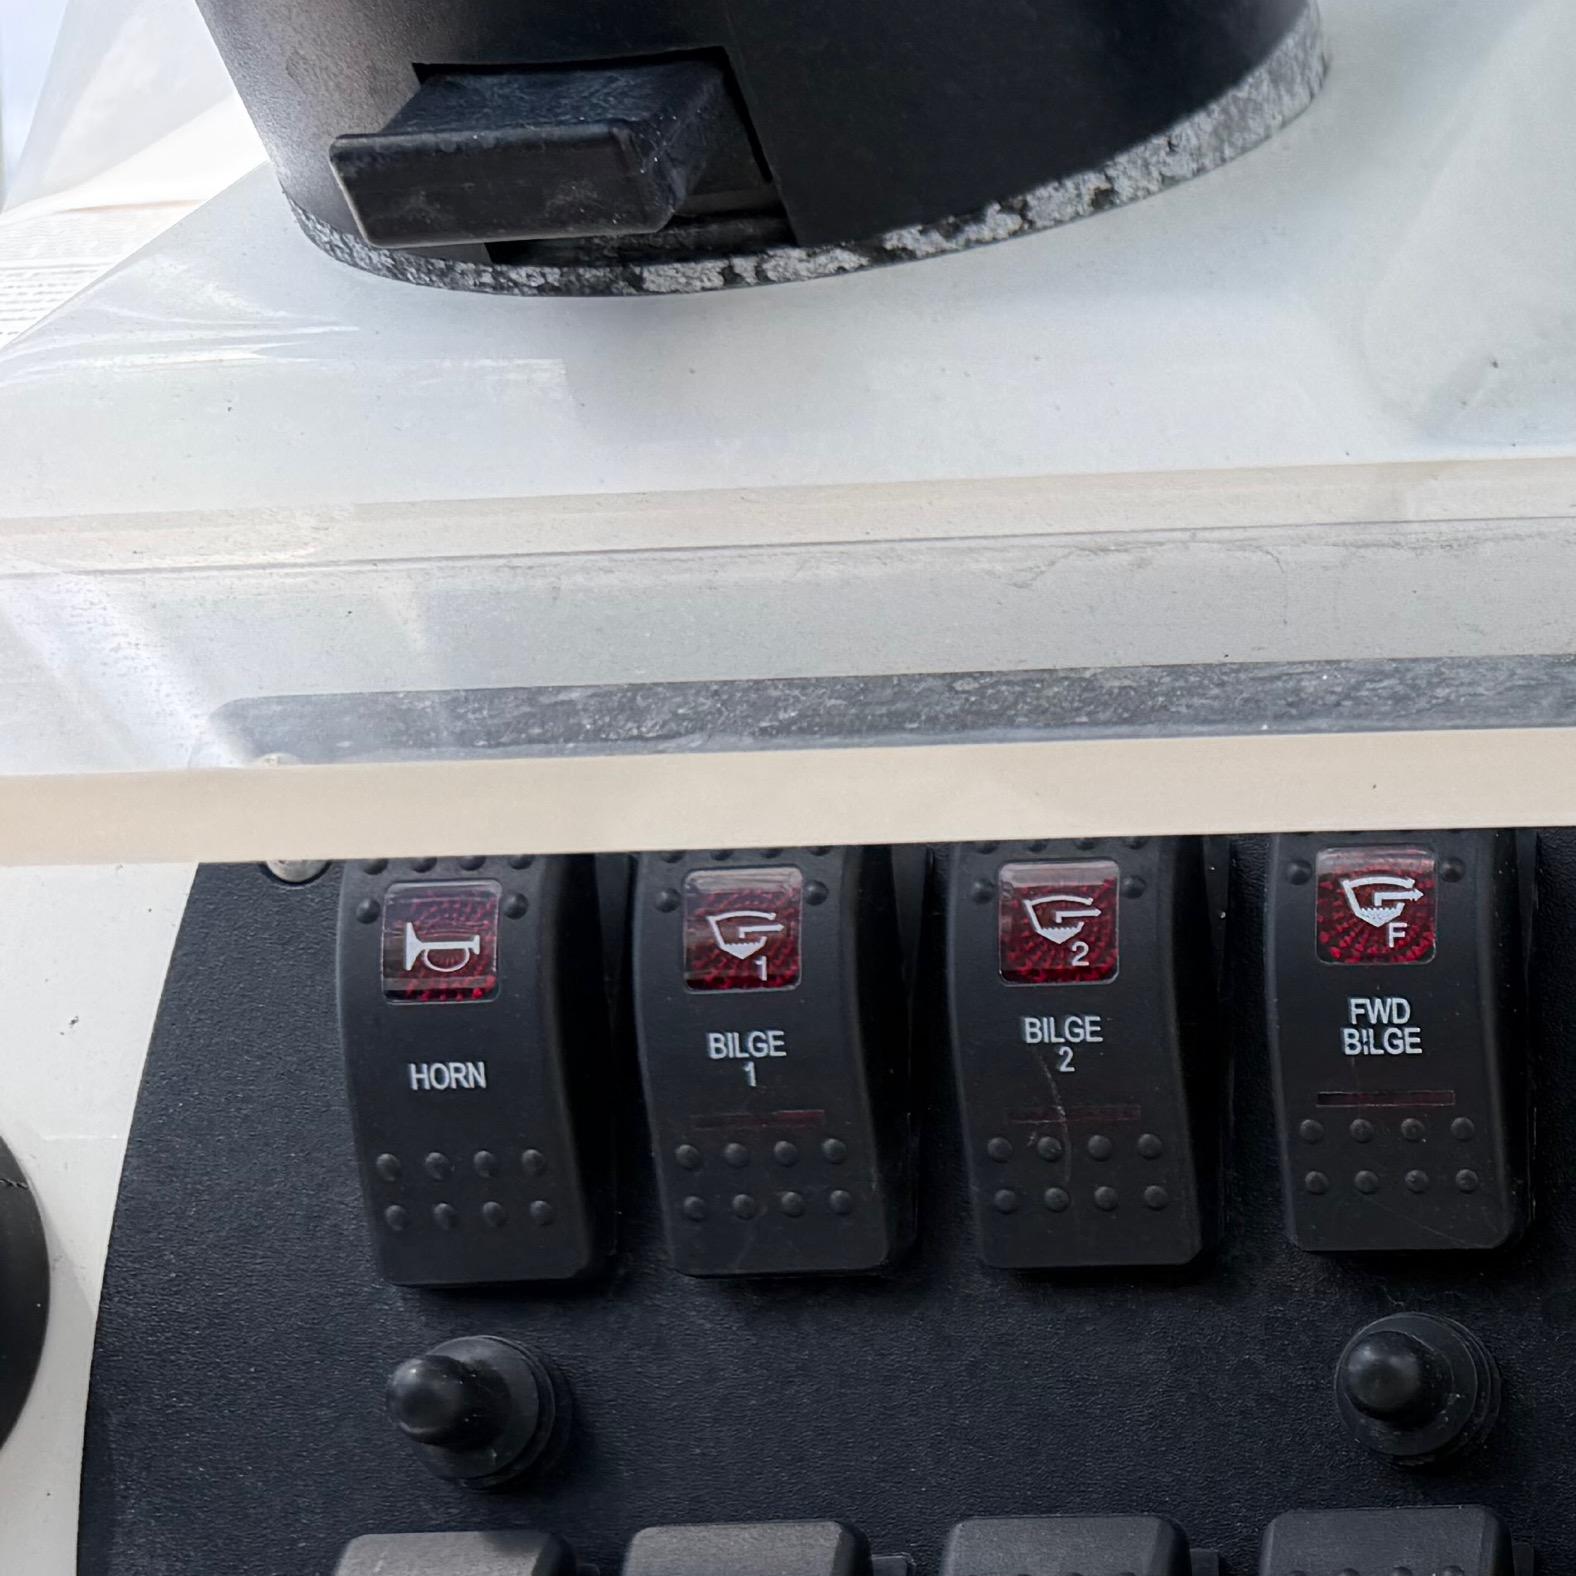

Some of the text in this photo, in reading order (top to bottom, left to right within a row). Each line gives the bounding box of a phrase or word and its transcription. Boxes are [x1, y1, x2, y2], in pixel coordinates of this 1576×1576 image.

[1387, 921, 1408, 948] F
[1070, 942, 1090, 967] 2
[754, 956, 768, 981] 1
[1350, 997, 1411, 1024] FWD
[1024, 1015, 1104, 1044] BILGE
[1343, 1027, 1423, 1055] BILGE
[708, 1030, 787, 1059] BILGE
[1058, 1045, 1075, 1072] 2
[410, 1061, 486, 1090] HORN
[743, 1061, 757, 1087] 1
